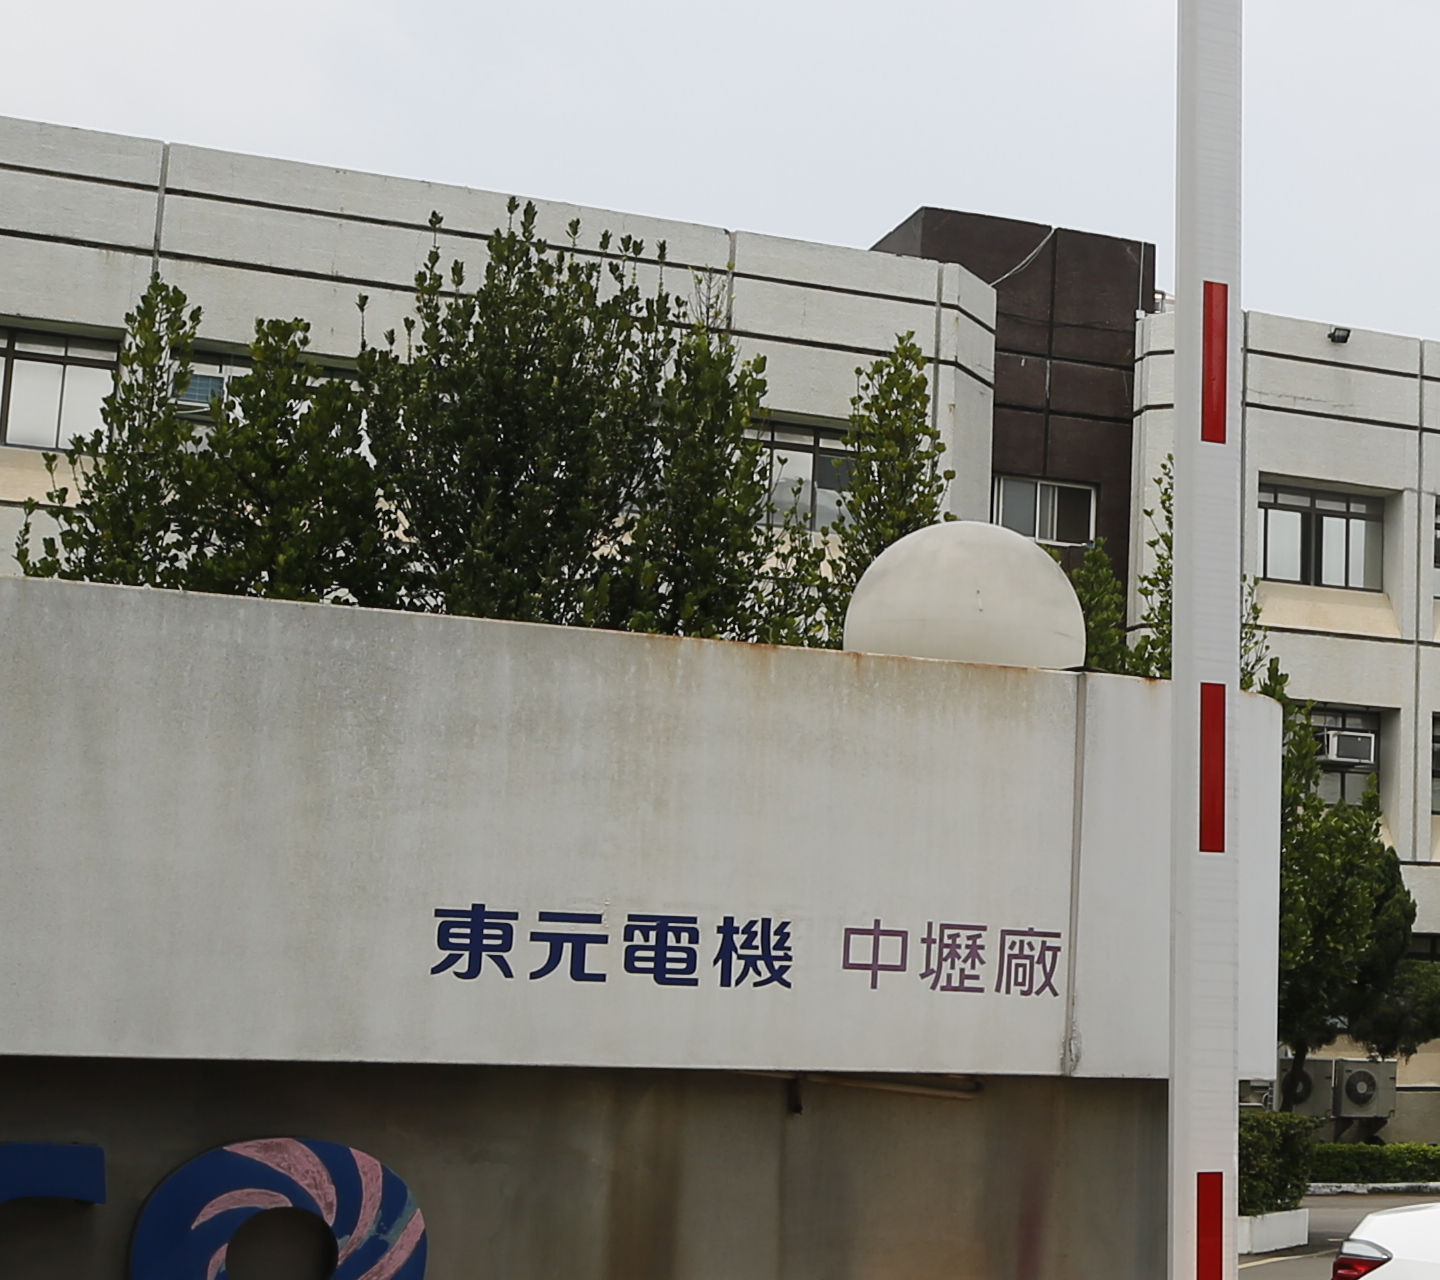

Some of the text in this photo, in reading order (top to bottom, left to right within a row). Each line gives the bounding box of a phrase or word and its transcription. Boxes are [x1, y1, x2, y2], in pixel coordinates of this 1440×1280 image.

[429, 903, 1062, 998] 東元電機 中壢廠
